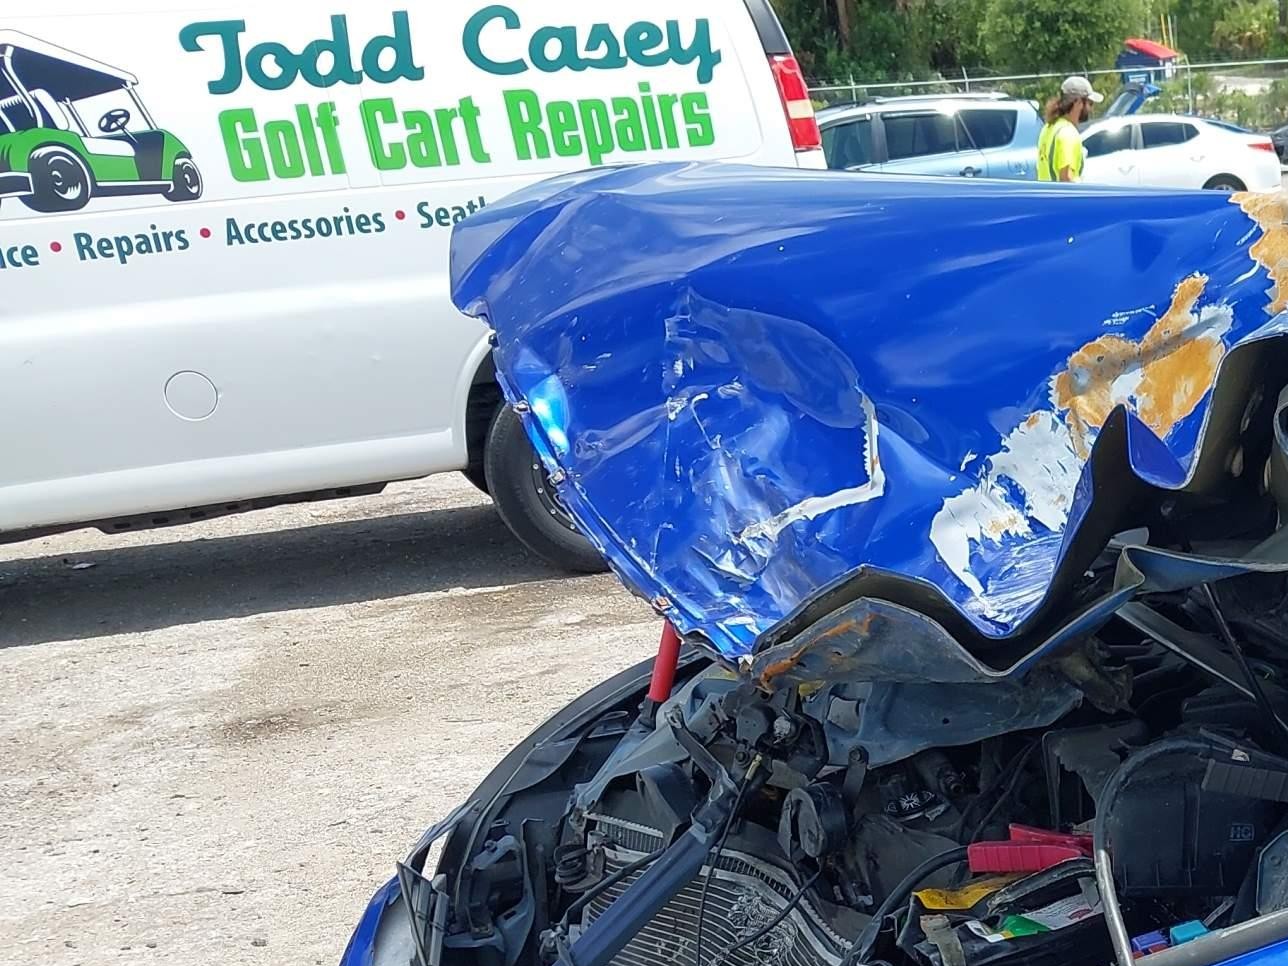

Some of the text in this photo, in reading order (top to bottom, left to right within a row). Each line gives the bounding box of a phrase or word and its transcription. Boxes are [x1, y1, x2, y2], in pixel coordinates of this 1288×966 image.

[179, 5, 722, 95] Todd Casey
[218, 82, 715, 181] Golf Cart Repairs
[74, 224, 190, 264] Repairs
[225, 206, 386, 246] Accessories
